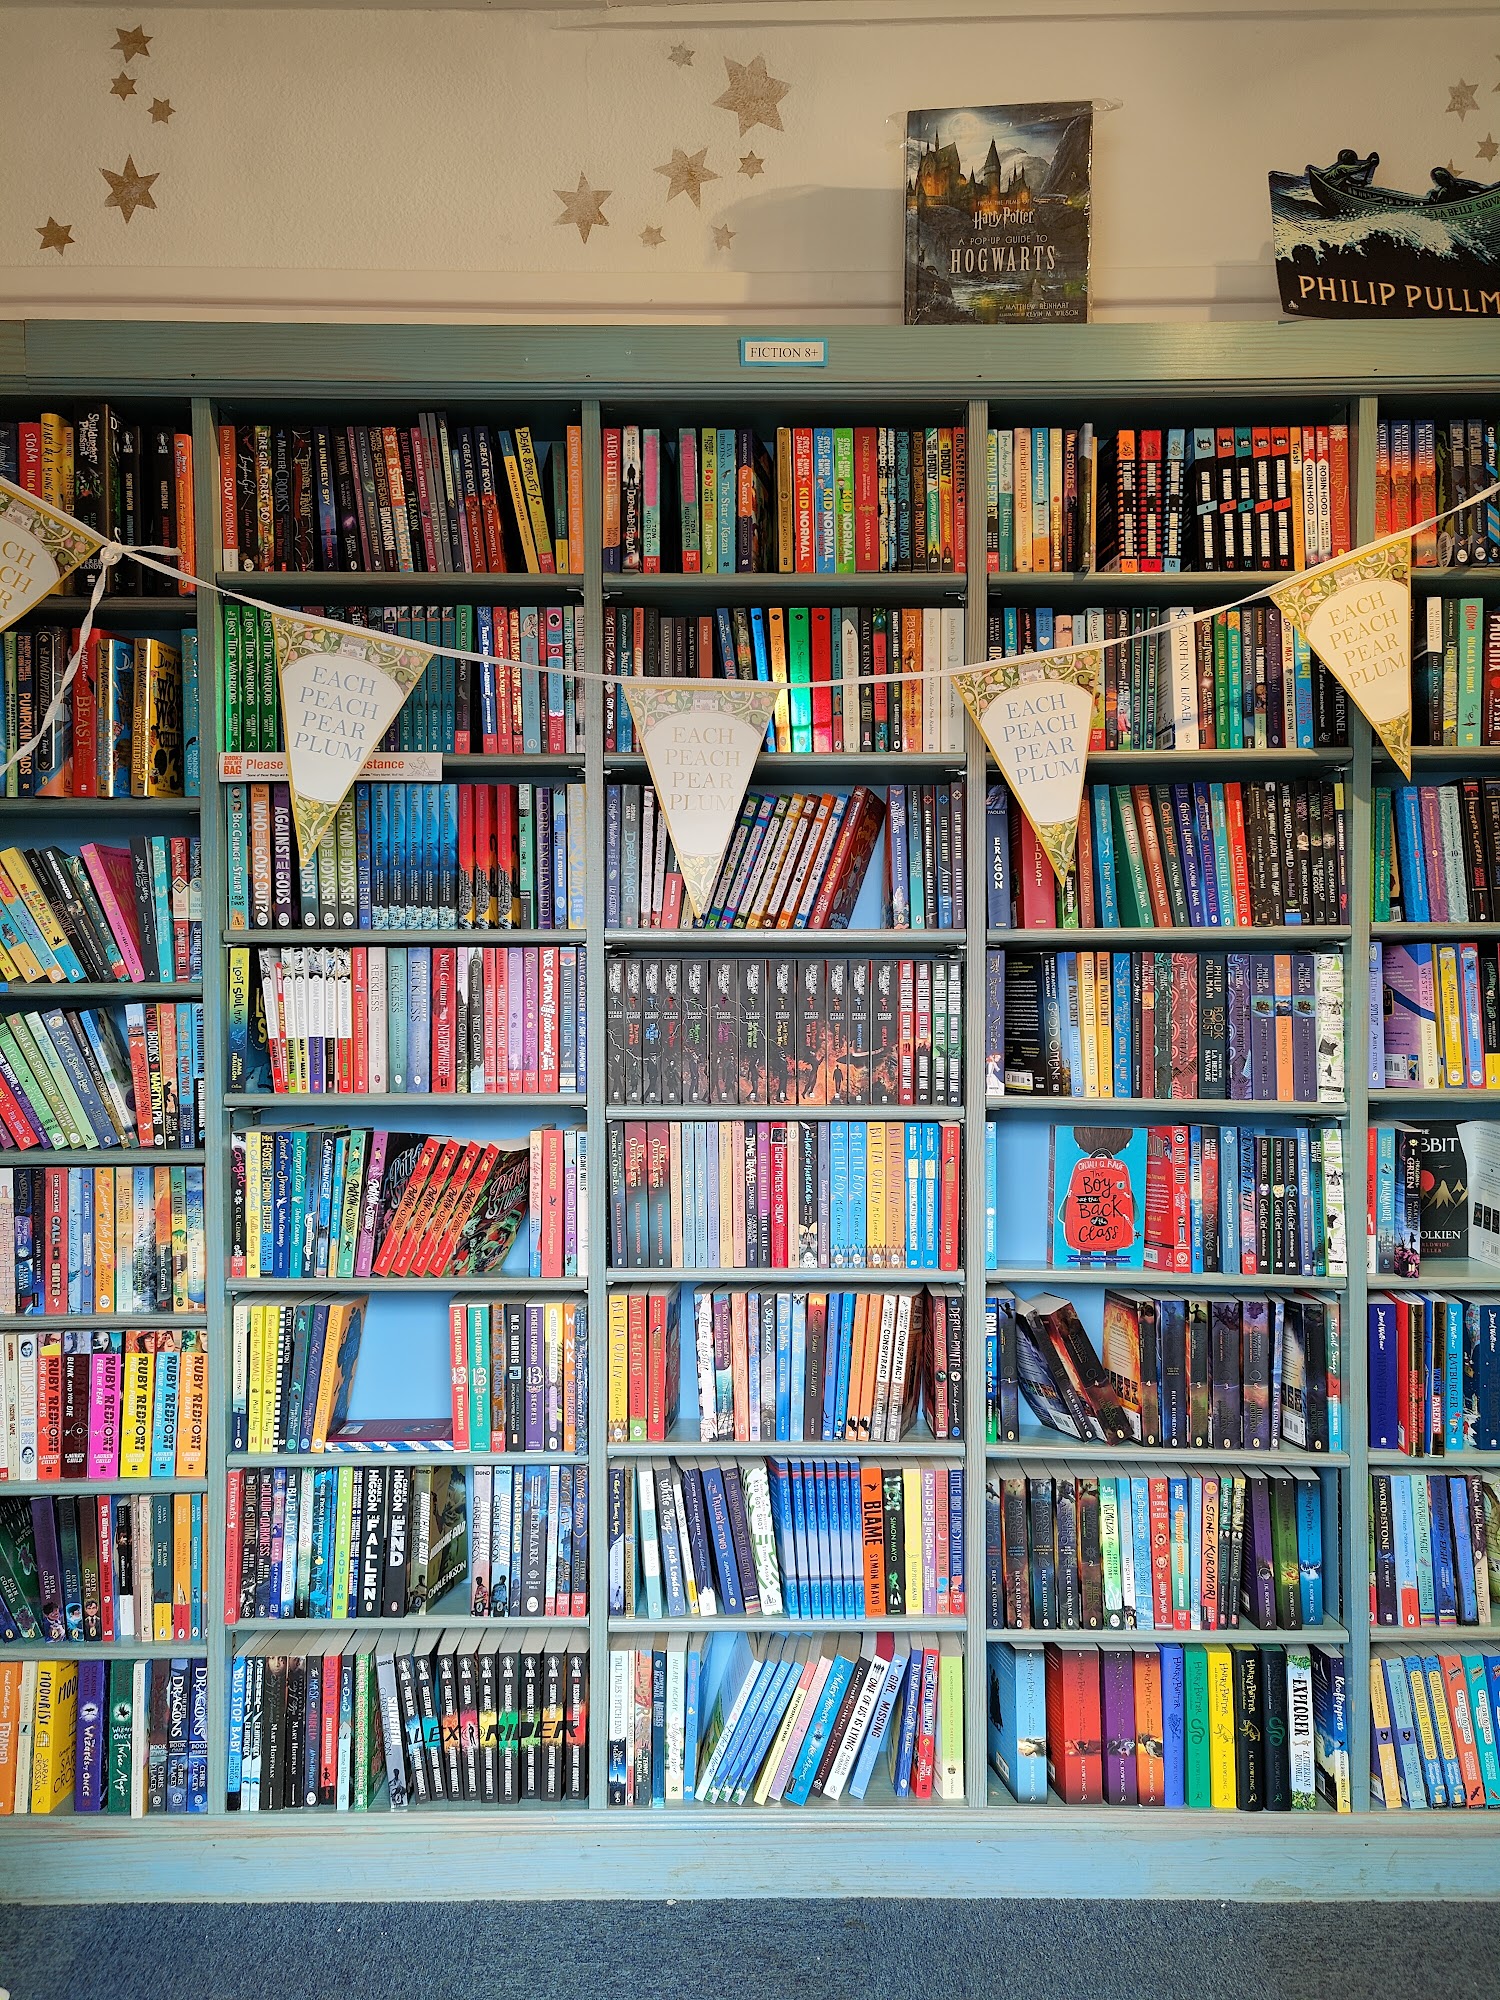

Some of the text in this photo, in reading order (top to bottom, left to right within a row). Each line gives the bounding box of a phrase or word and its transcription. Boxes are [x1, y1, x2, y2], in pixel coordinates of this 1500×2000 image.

[972, 206, 1035, 230] Harry Potter
[1448, 205, 1474, 216] BELLE
[1006, 235, 1030, 243] GUIDE
[951, 246, 1055, 273] HOGWARTS
[1040, 301, 1069, 309] REINHART
[1298, 275, 1395, 305] PHILIP
[750, 347, 818, 357] FICTION 8+
[24, 433, 37, 463] STORM
[1066, 433, 1076, 488] WAR STORIES
[1292, 441, 1300, 465] Trash
[318, 434, 330, 506] AN UNLIKELY SPY
[463, 444, 476, 496] GREAT REVOLT
[928, 454, 937, 480] DEADLY
[1018, 438, 1030, 513] michael morpurgo
[740, 482, 749, 507] Secret
[1306, 490, 1314, 515] HOOD
[224, 477, 235, 546] SOUP MOVEMENT
[799, 488, 810, 561] KID NORMAL
[824, 489, 833, 562] KID NORMAL
[488, 527, 497, 558] DOWSWELL
[722, 527, 731, 554] Kazan
[914, 510, 925, 559] ROBIN JARVIS
[1328, 590, 1386, 627] EACH
[1329, 609, 1399, 650] PEACH
[1343, 632, 1399, 668] PEAR
[228, 660, 238, 705] WARRIORS
[311, 666, 378, 696] EACH
[1178, 624, 1191, 724] GARTH NIX LIRAEL
[1348, 653, 1407, 688] PLUM
[299, 686, 380, 720] PEACH
[1005, 693, 1067, 720] EACH
[76, 696, 91, 747] BEAST
[301, 710, 366, 740] PEAR
[673, 727, 735, 745] EACH
[1002, 713, 1078, 743] PEACH
[293, 731, 365, 762] PLUM
[665, 749, 741, 767] PEACH
[1014, 736, 1076, 764] PEAR
[223, 765, 242, 775] BAG
[246, 759, 284, 770] Please
[363, 759, 404, 769] stance
[672, 772, 734, 788] PEAR
[1016, 758, 1081, 786] PLUM
[669, 794, 735, 811] PLUM
[253, 801, 269, 880] WHO GODS
[275, 806, 290, 905] AGAINST ALL GODS
[339, 802, 354, 907] BEYOND THE ODYSSEY
[539, 802, 550, 918] OGRE ENCHANTED
[624, 831, 636, 903] DREAM MAGIC
[993, 837, 1003, 890] ERAGON
[1235, 845, 1248, 913] MICHELLE PAVER
[176, 927, 187, 970] JENNIFER BELL
[1206, 959, 1222, 999] PHILIP PULLMAN
[438, 954, 450, 1077] Neil Gaiman NEVERWHERE
[148, 1032, 159, 1062] BROOKS
[150, 1072, 163, 1106] MARTYN
[154, 1108, 163, 1125] PIG
[774, 1146, 783, 1169] EIGHT
[774, 1170, 783, 1194] PIECES
[1083, 1177, 1115, 1198] Boy
[775, 1203, 783, 1224] SILVA
[1079, 1195, 1123, 1218] Back
[51, 1216, 65, 1245] CALL
[1079, 1226, 1118, 1242] Class
[1420, 1230, 1461, 1239] OLKIEN
[510, 1336, 519, 1363] HARRIS
[879, 1330, 891, 1380] CONSPIRACY
[48, 1357, 59, 1453] RUBY REDFORT
[135, 1357, 148, 1452] RUBY REDFORT
[367, 1470, 379, 1512] HIGSON
[864, 1501, 883, 1546] BLAME
[389, 1520, 406, 1567] END
[336, 1551, 345, 1600] SQUIRM
[363, 1520, 379, 1601] FALLEN
[869, 1554, 880, 1580] SIMON
[870, 1583, 880, 1605] MAYO
[39, 1671, 51, 1725] MOONRISE
[231, 1673, 244, 1753] BUS STOP BABY
[1292, 1679, 1309, 1737] EXPLORER
[1333, 1675, 1345, 1732] Rooftoppers
[845, 1677, 878, 1752] ONE OF US IS LYING
[871, 1700, 890, 1738] MISSING
[82, 1773, 91, 1797] ONCE
[1293, 1750, 1311, 1788] KATHERINE RUNDELL
